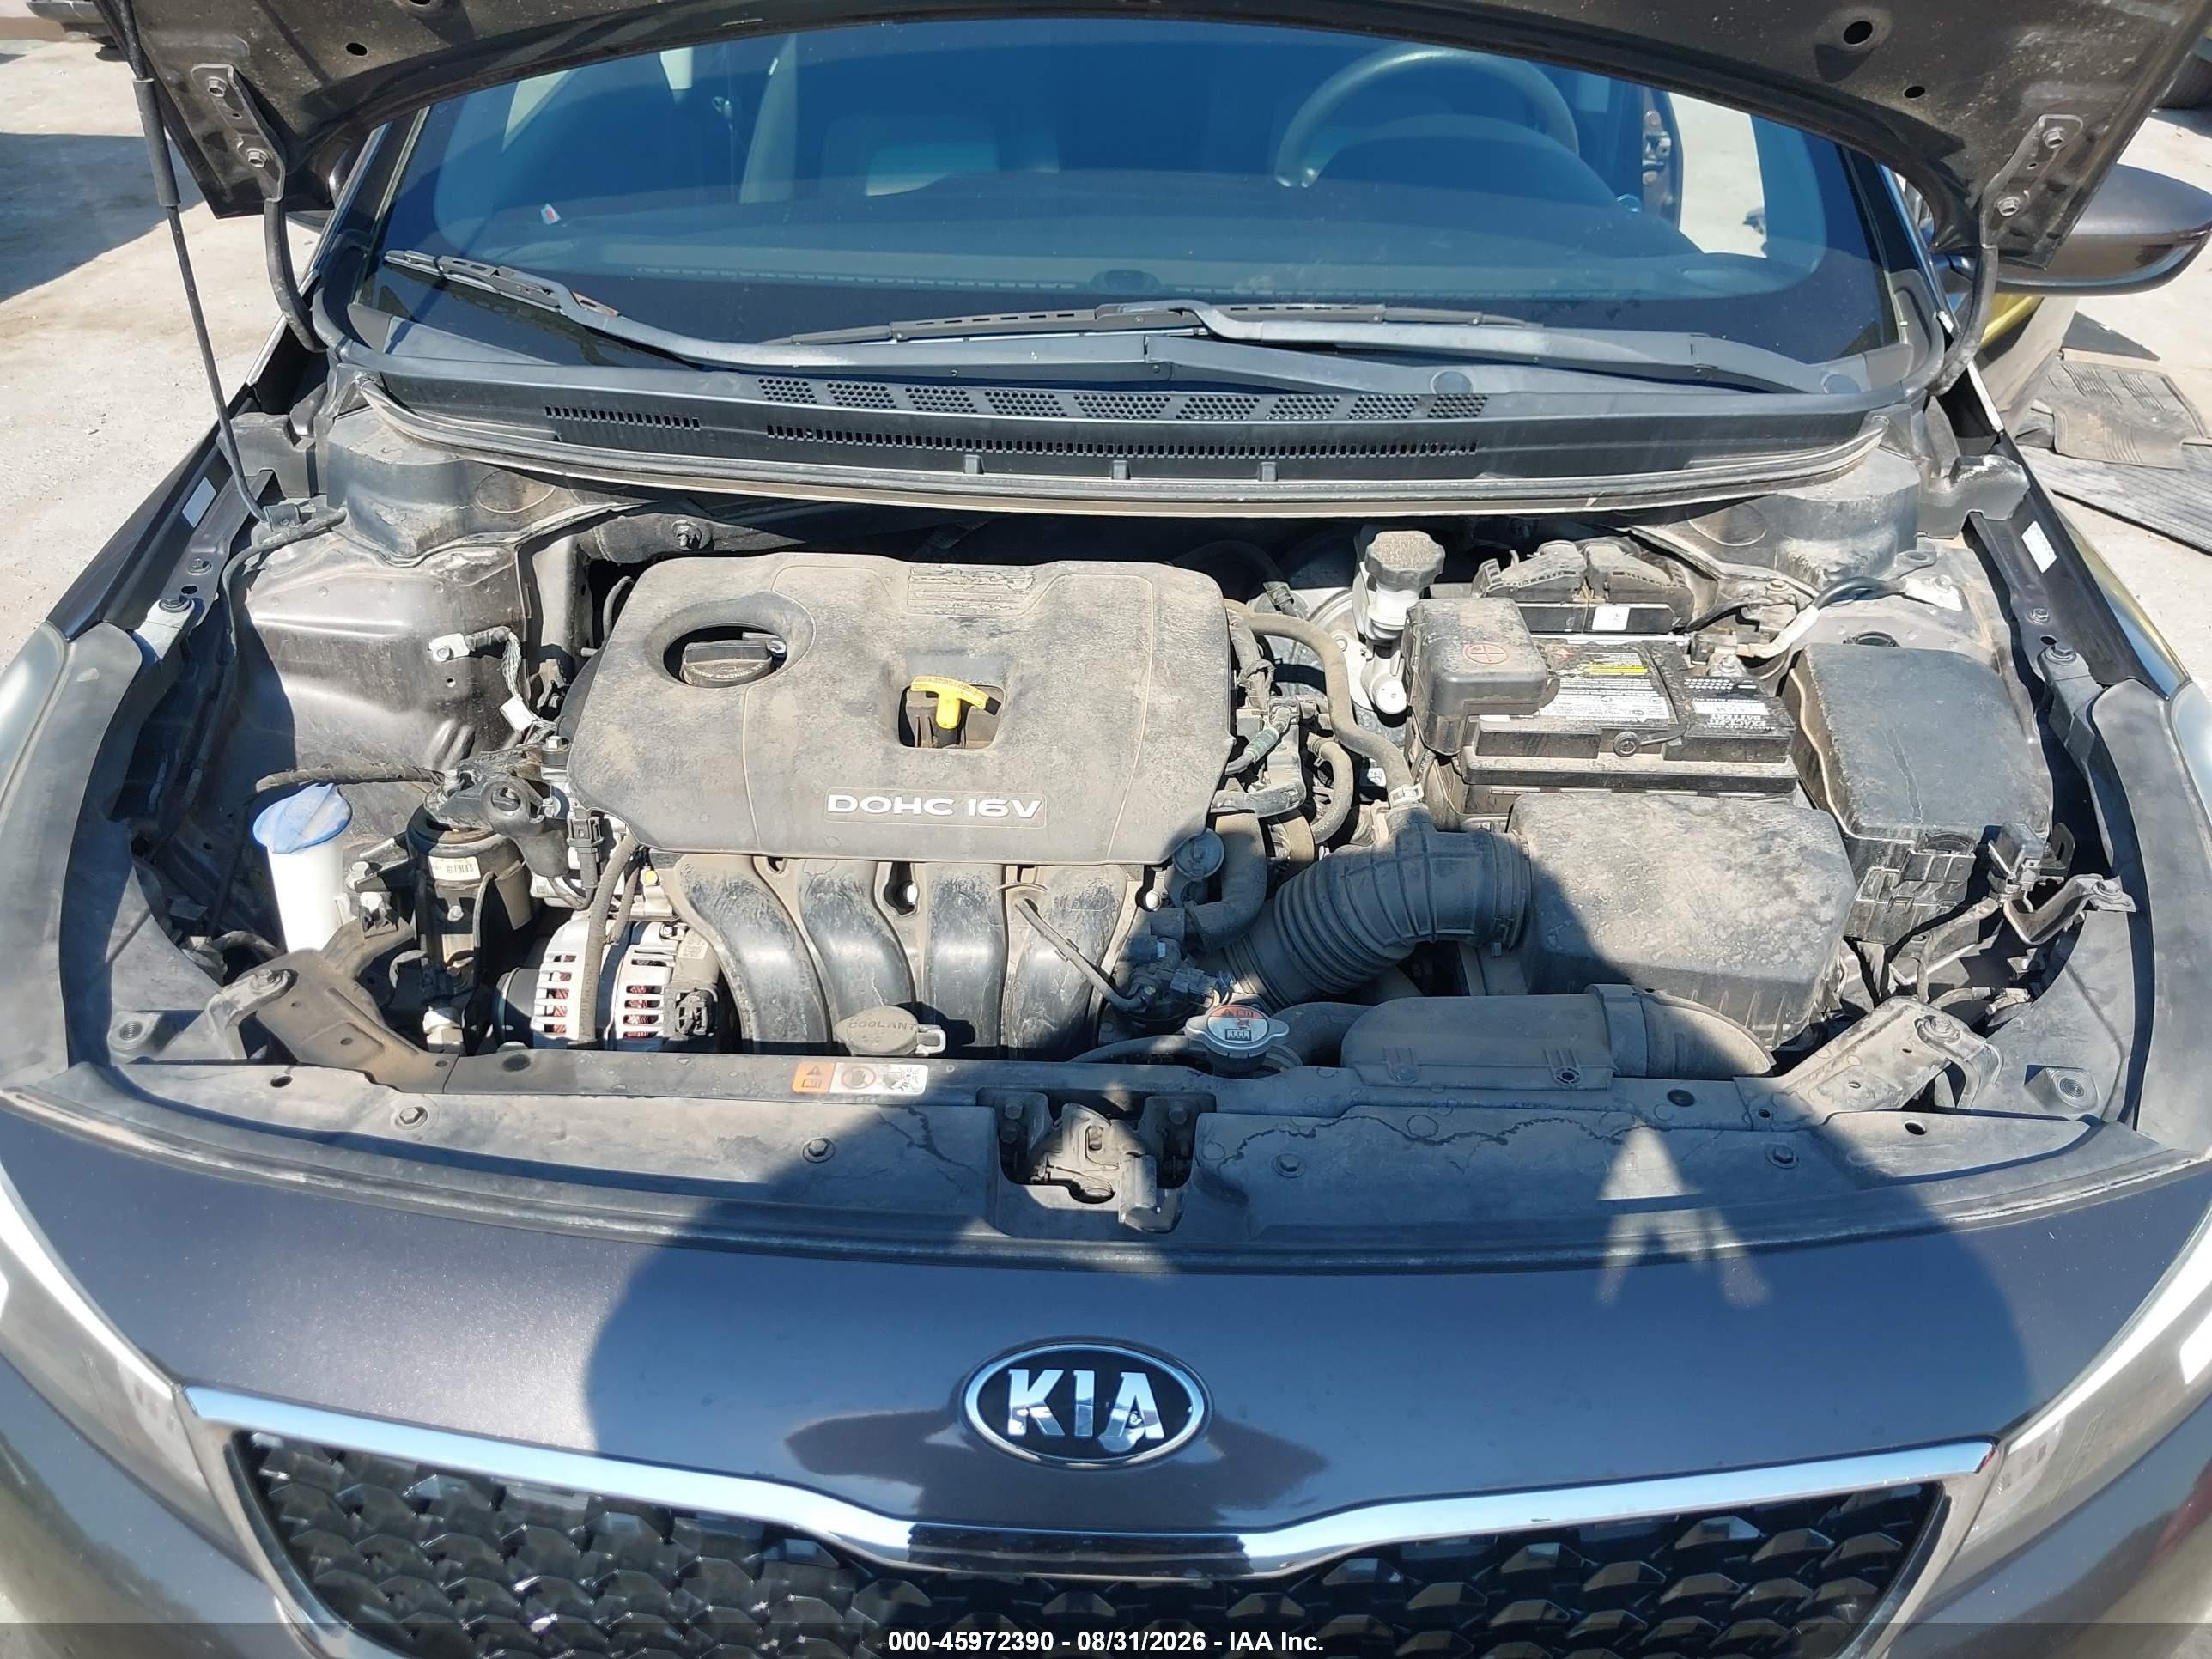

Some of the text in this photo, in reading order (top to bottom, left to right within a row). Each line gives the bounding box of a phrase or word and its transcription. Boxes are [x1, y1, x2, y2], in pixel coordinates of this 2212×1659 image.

[827, 794, 1042, 818] DOHC 16V
[848, 1019, 917, 1031] COOLANT
[1007, 1369, 1165, 1440] KIA
